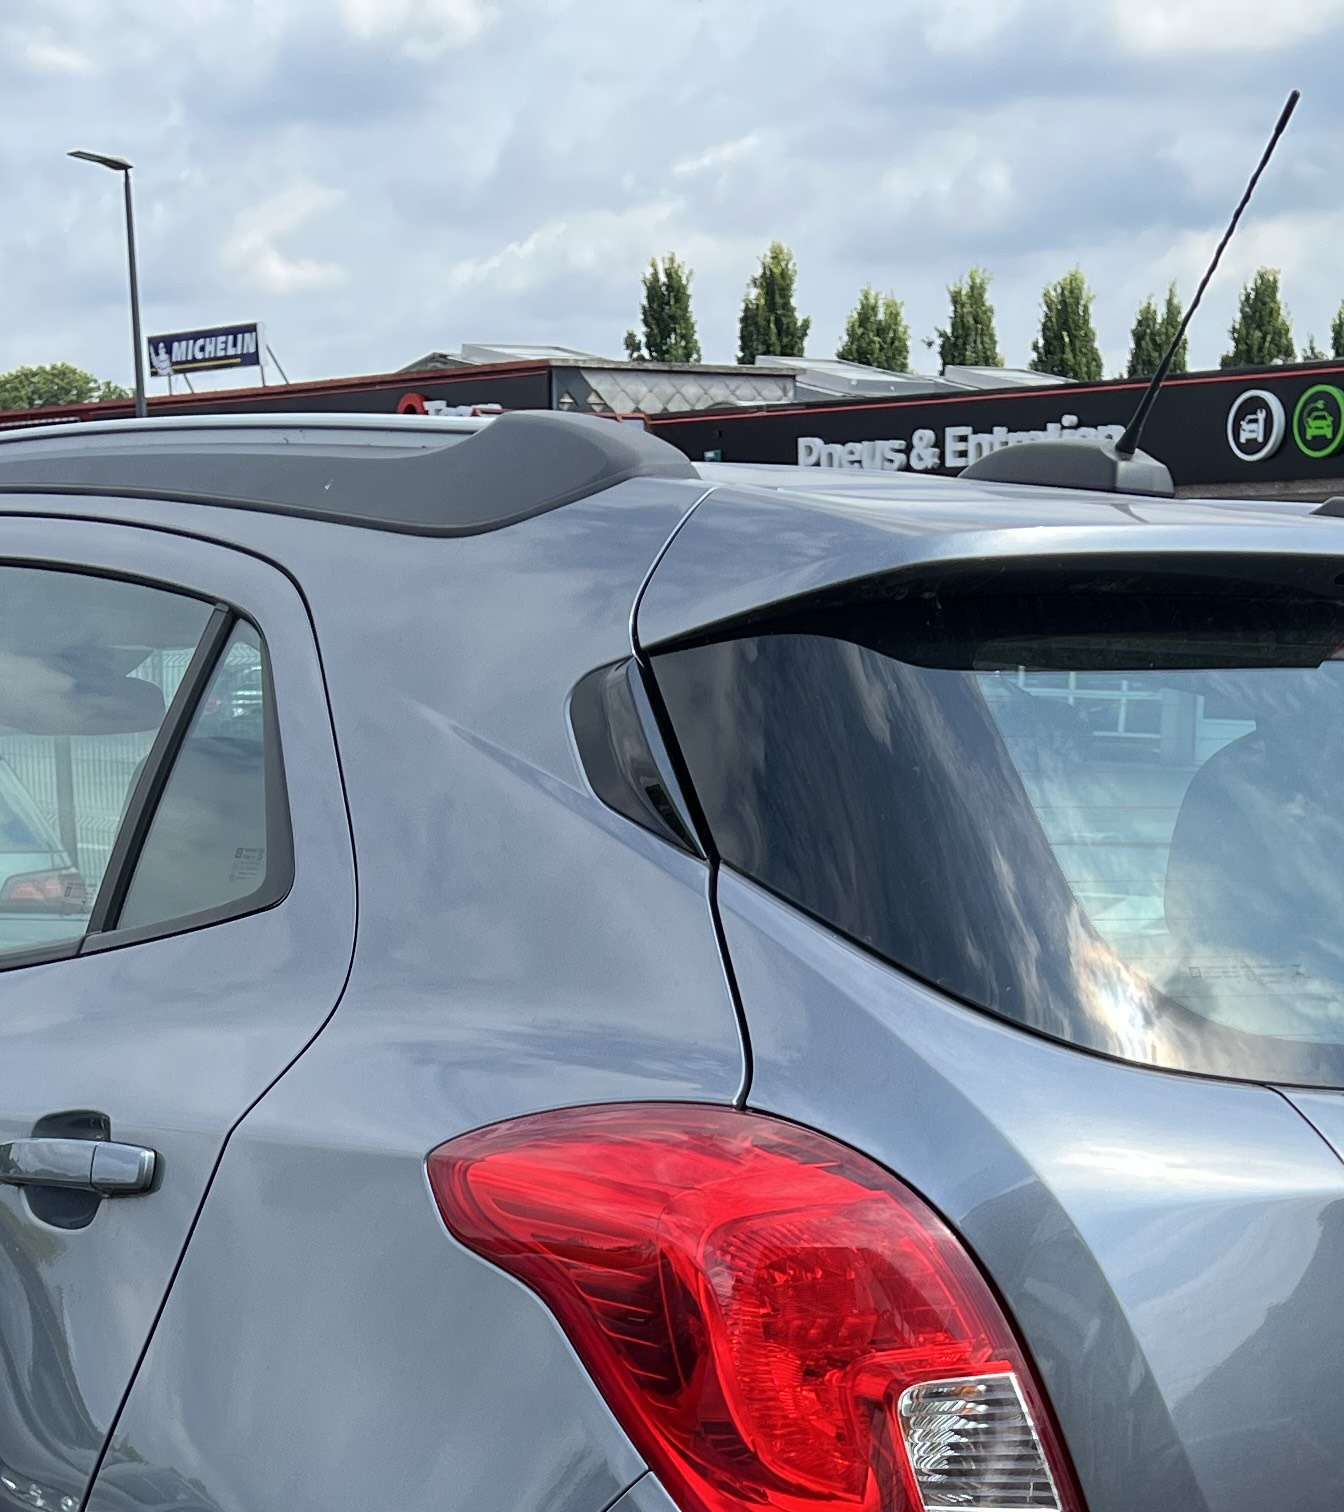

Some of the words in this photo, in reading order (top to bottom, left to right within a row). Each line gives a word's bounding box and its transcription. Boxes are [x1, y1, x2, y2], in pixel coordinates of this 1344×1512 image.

[171, 332, 257, 362] MICHELIN
[797, 436, 907, 472] Pneus
[909, 428, 941, 470] &
